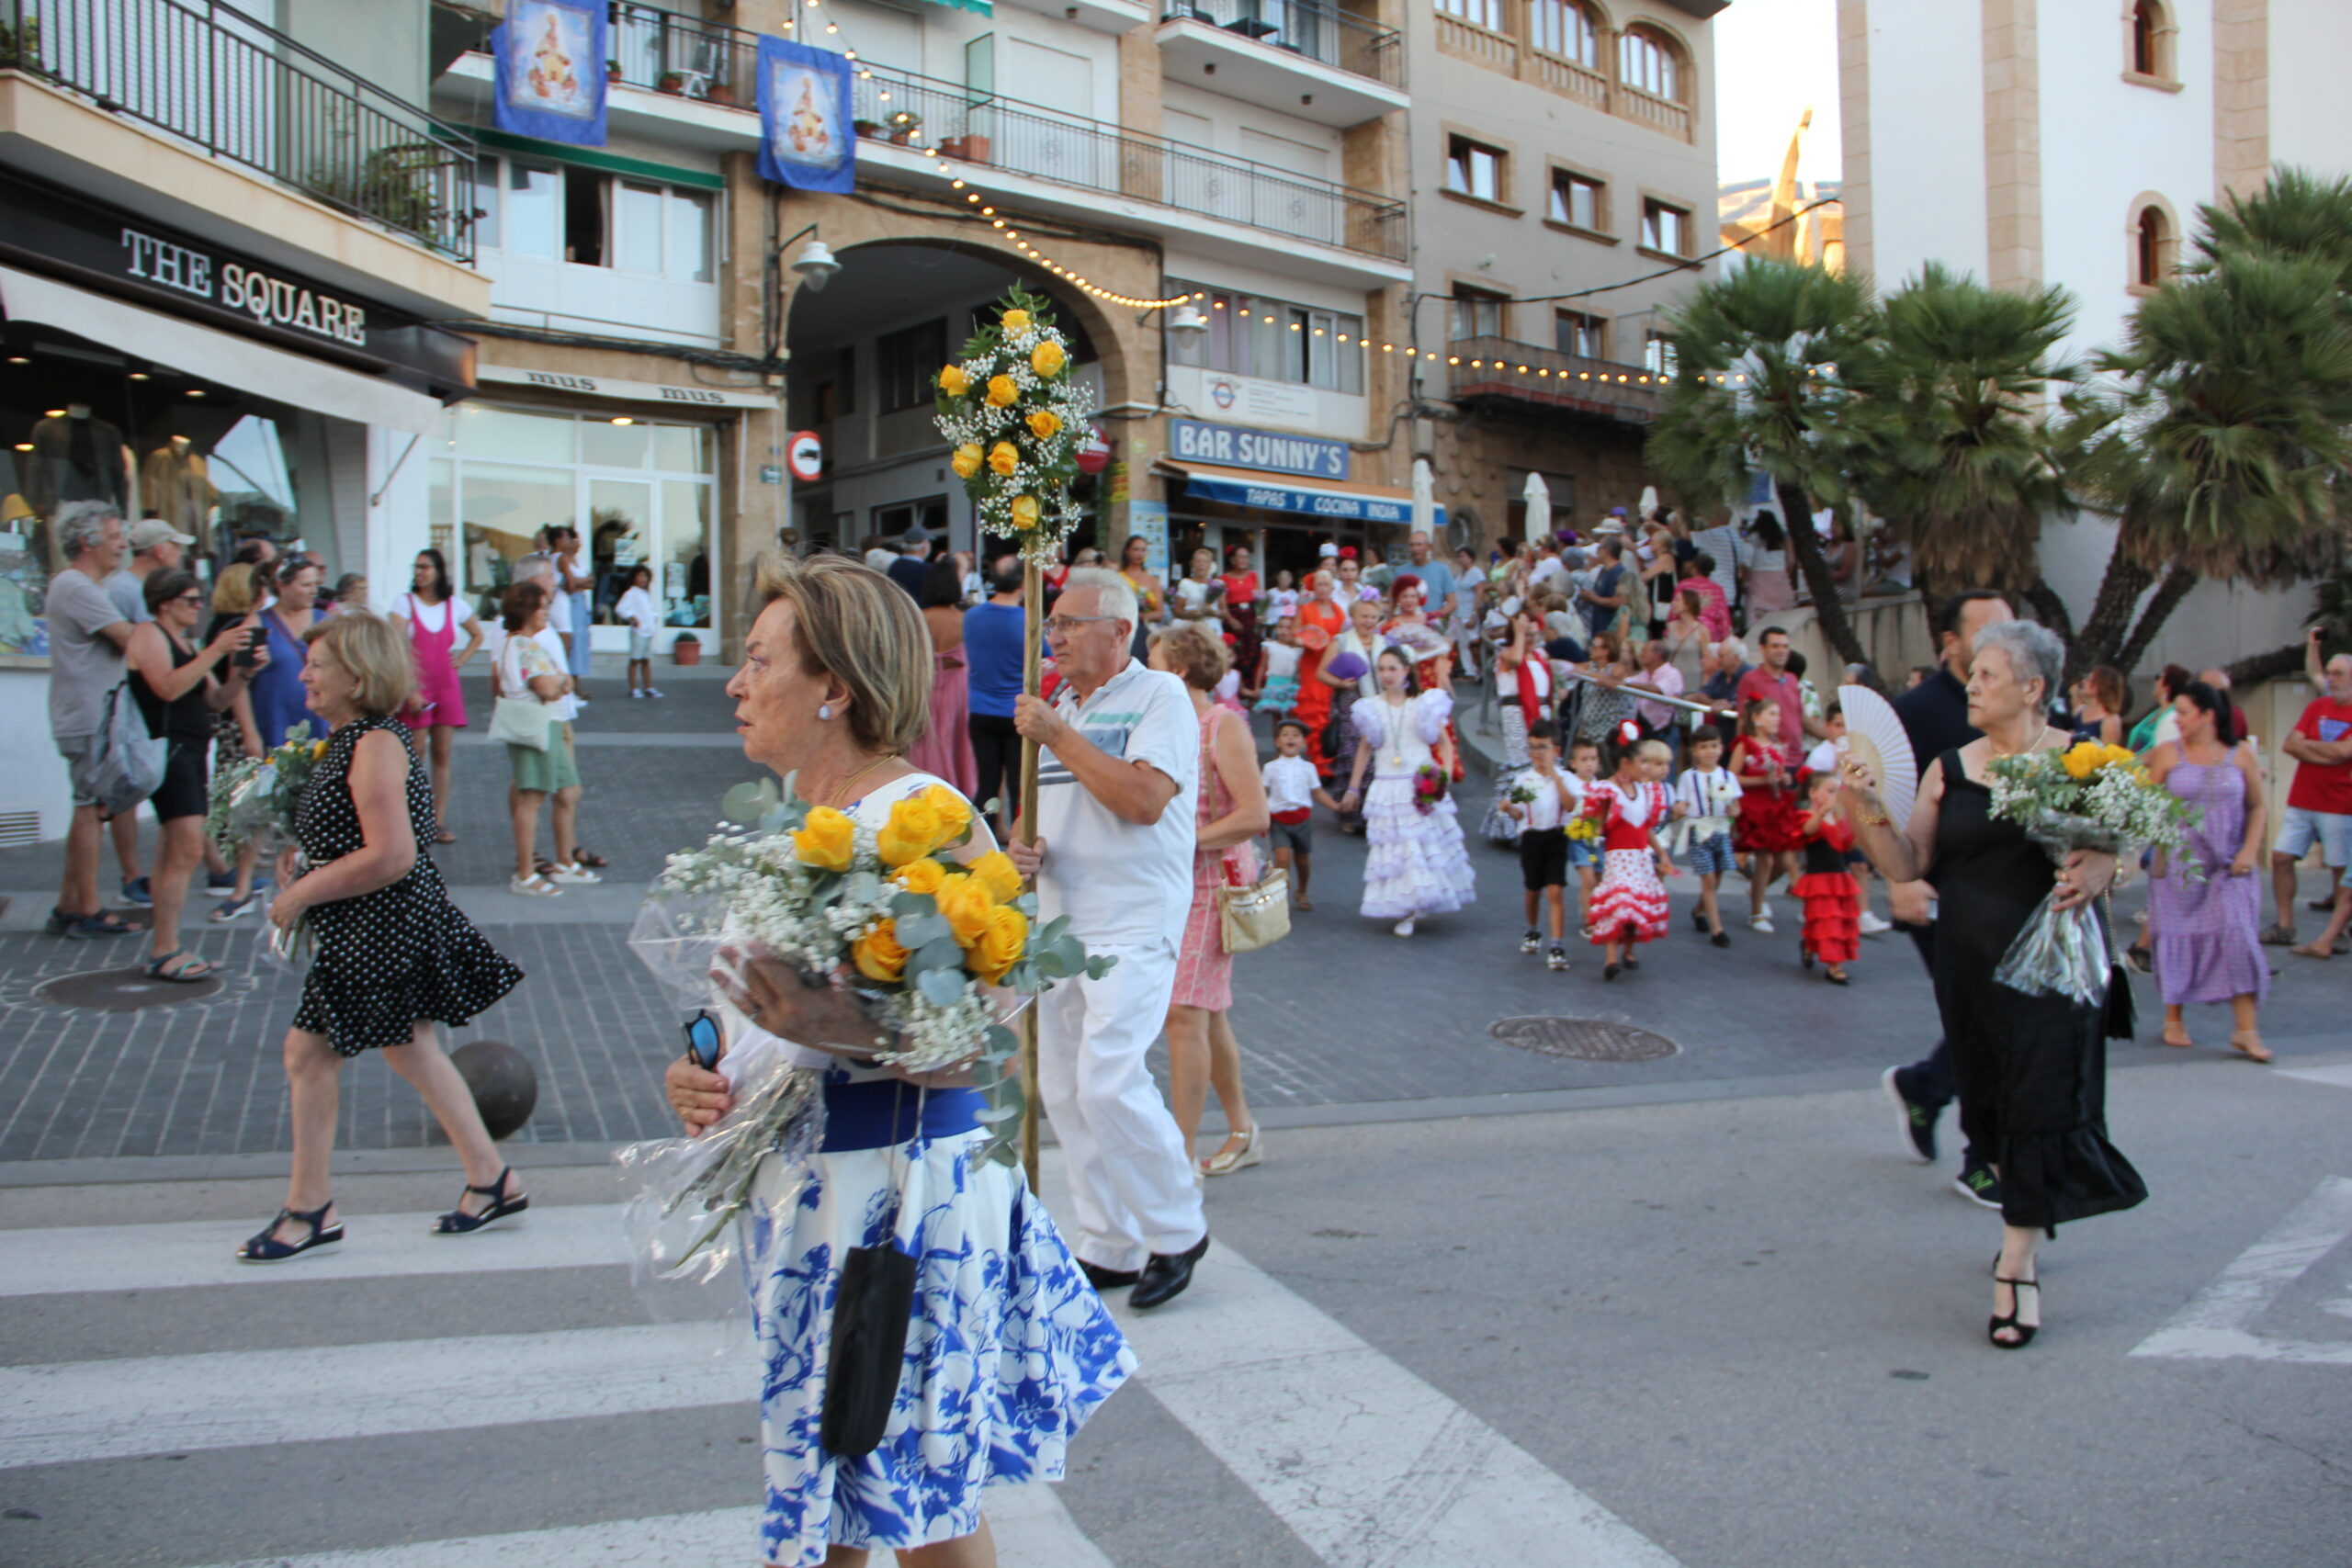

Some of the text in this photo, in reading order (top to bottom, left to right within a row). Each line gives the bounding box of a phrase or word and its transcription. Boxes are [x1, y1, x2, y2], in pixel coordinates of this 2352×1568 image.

[121, 228, 367, 346] THE SQUARE
[526, 370, 725, 404] mus mus
[1180, 425, 1342, 474] BAR SUNNY'S
[1246, 489, 1399, 519] TAPAS Y COCINA INDIA
